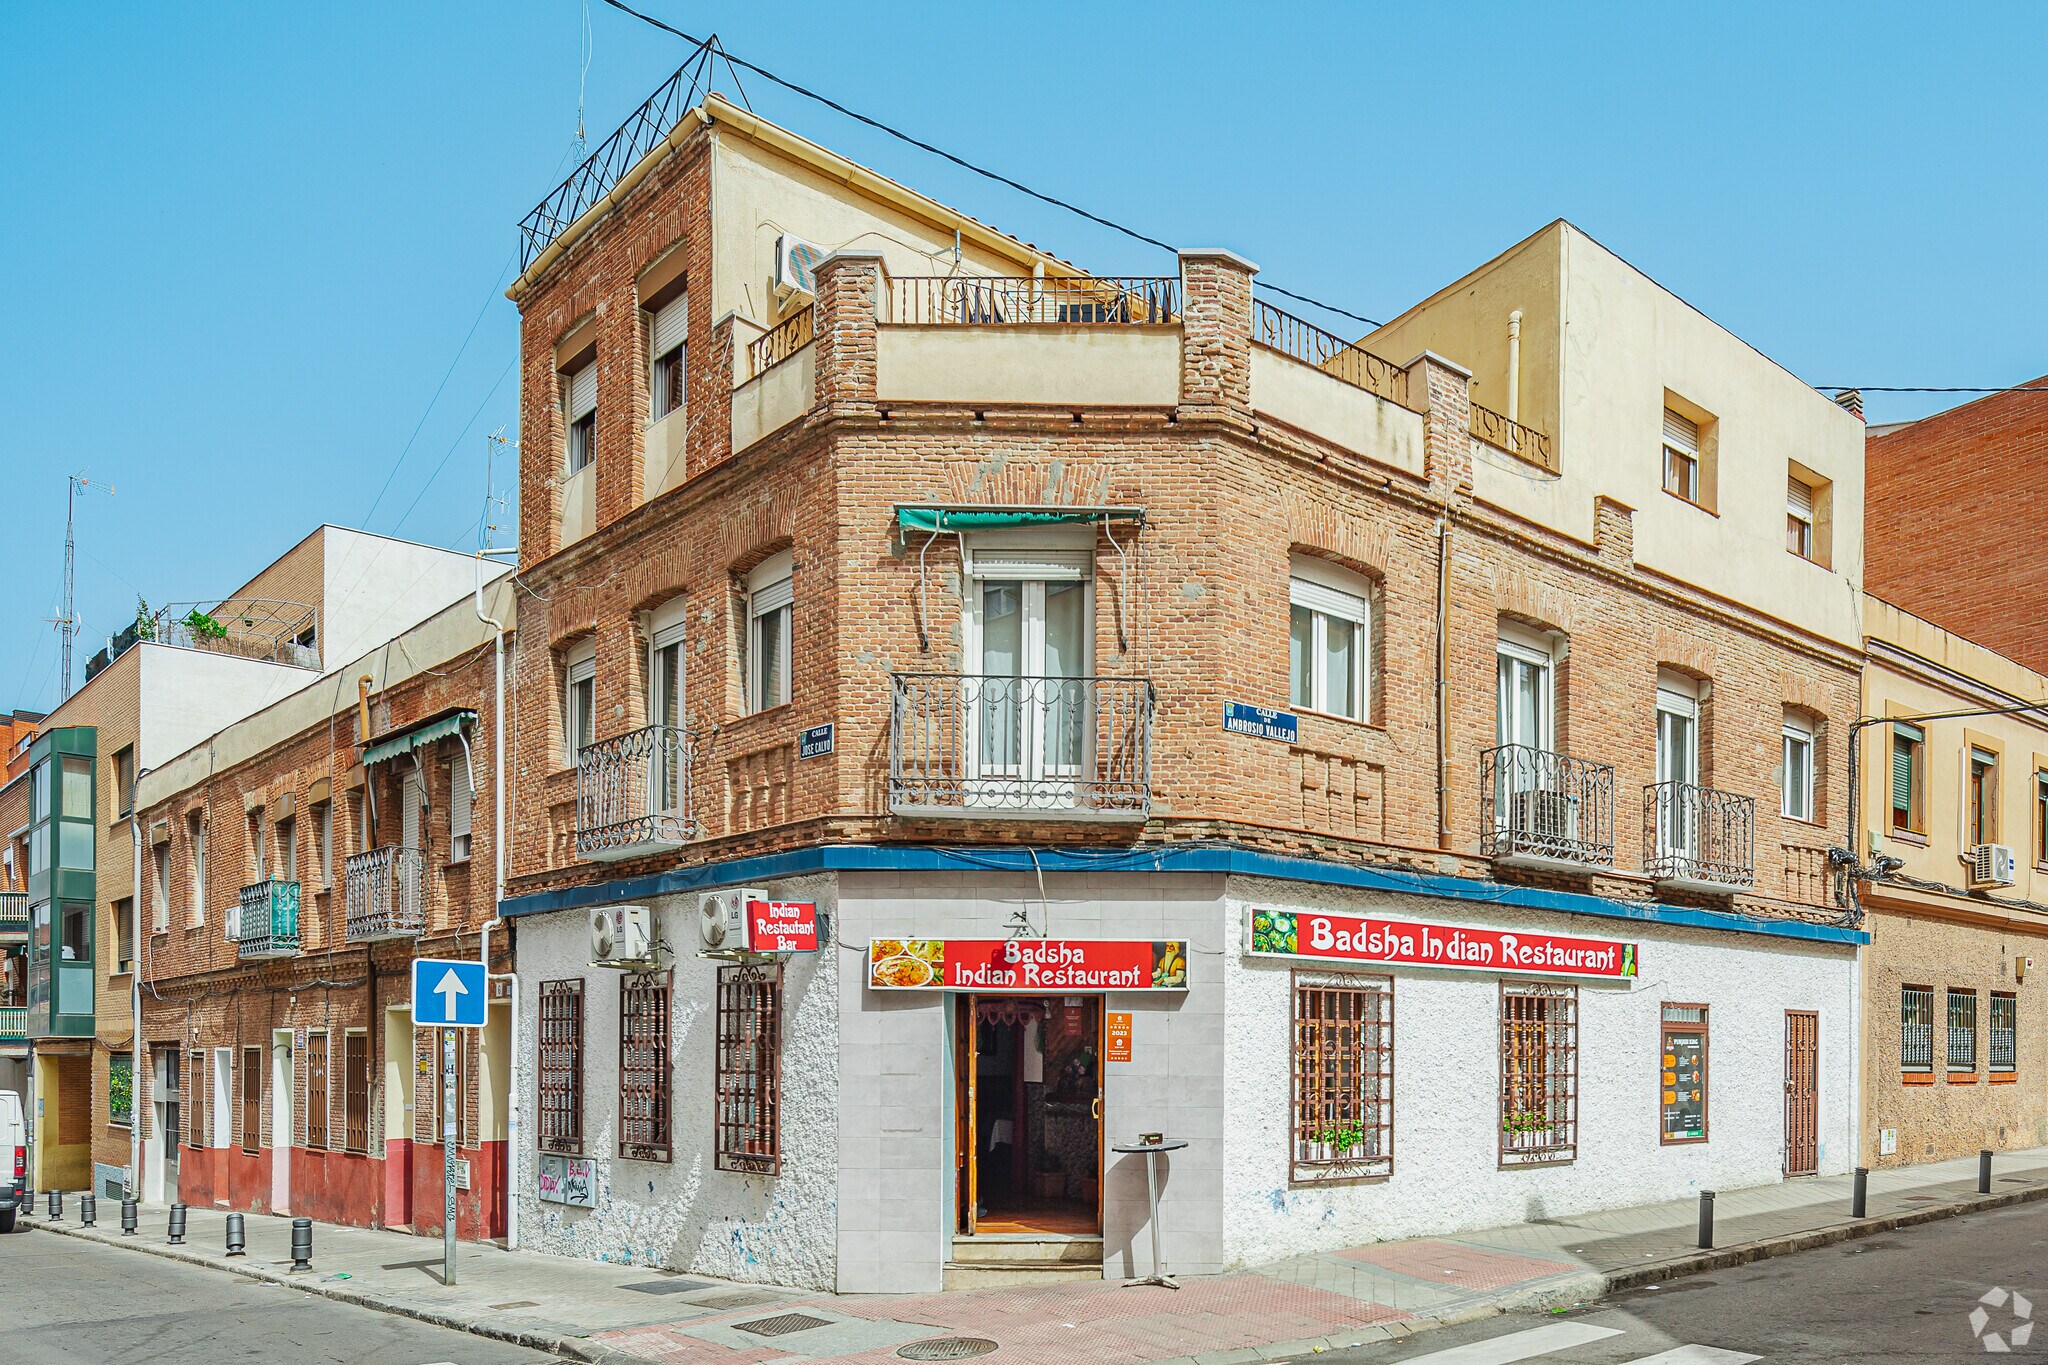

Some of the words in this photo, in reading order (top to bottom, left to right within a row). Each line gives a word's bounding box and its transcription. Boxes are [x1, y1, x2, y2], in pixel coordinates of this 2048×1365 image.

[1256, 708, 1278, 719] CALLE
[811, 727, 828, 738] CALLE
[1227, 717, 1264, 735] AMBROSIO
[1265, 724, 1296, 742] VALLEJO
[814, 739, 831, 753] CALVO
[730, 911, 739, 919] LG
[768, 902, 800, 919] Indian
[616, 925, 623, 933] LG
[776, 935, 797, 951] Bar
[1310, 917, 1414, 961] Badsha
[1421, 927, 1493, 965] Indian
[1499, 934, 1615, 971] Restaurant
[1004, 939, 1084, 968] Badsha
[955, 961, 1017, 987] Indian
[1022, 963, 1141, 987] Restaurant
